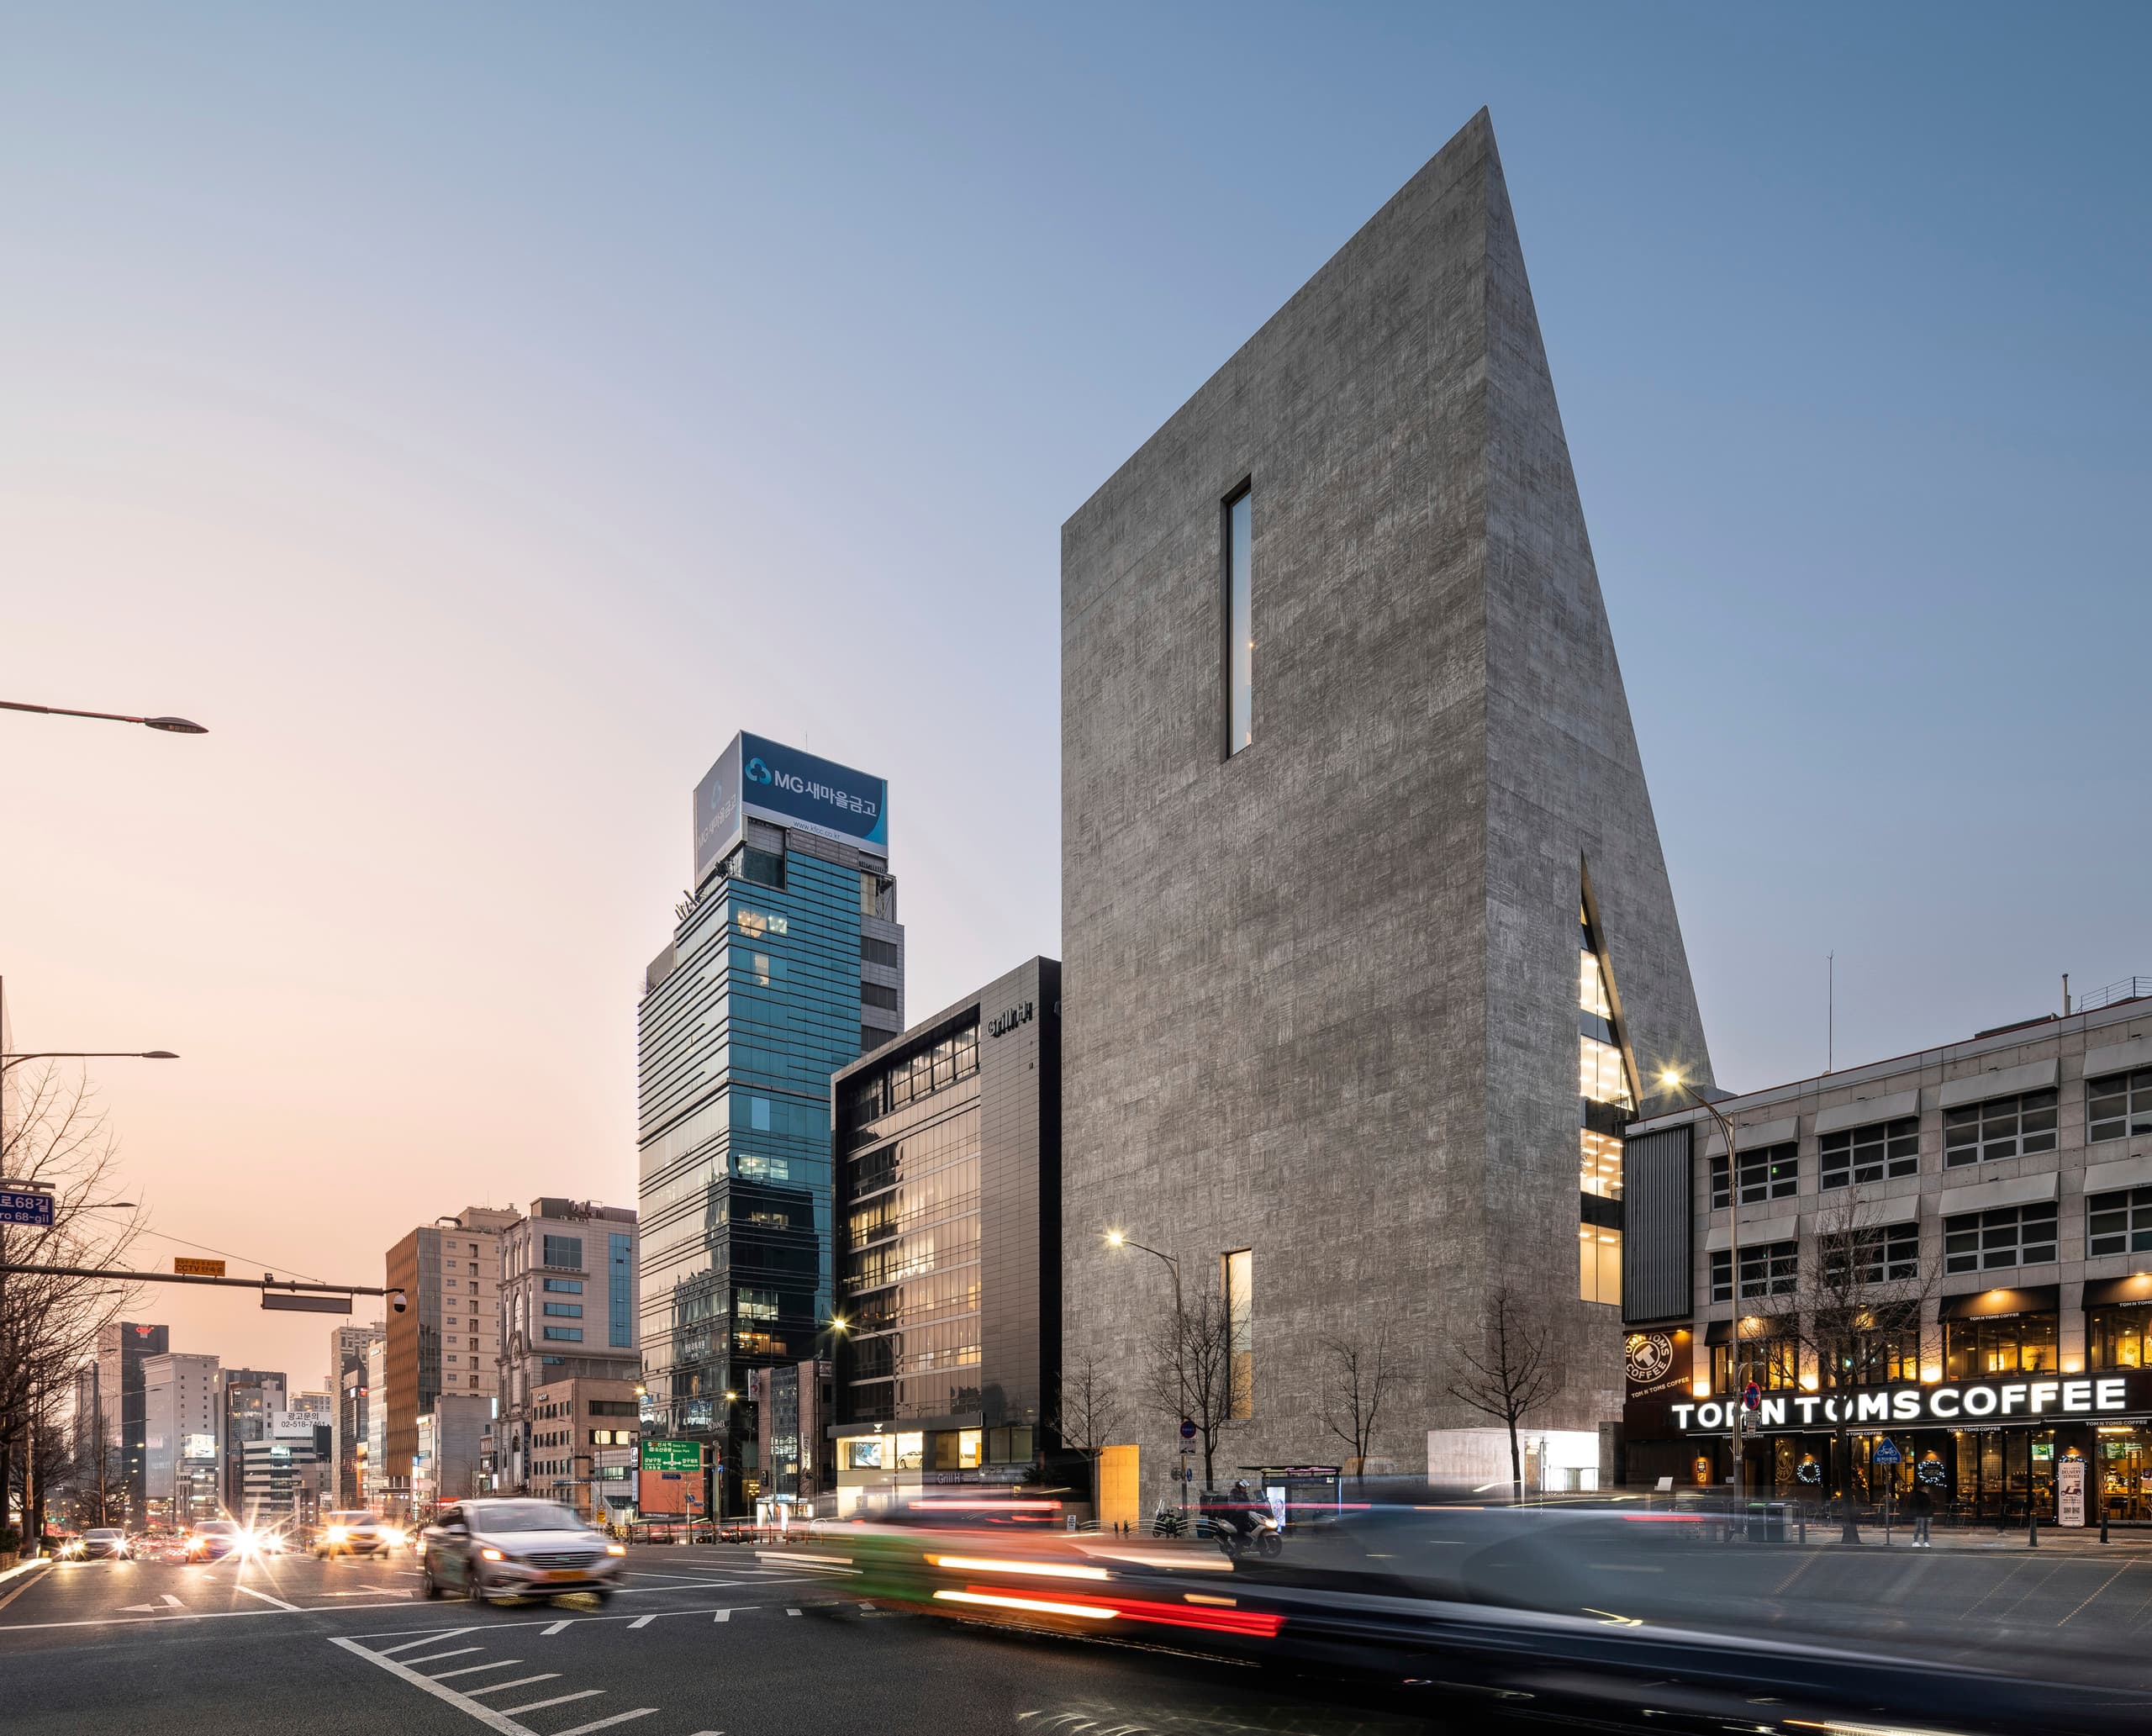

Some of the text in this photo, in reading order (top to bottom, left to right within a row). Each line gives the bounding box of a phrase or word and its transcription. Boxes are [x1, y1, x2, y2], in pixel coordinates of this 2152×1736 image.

[774, 770, 877, 817] MG 새마을금고
[793, 821, 841, 840] www.kfcc.co.kr
[0, 1195, 49, 1213] 로68길
[15, 1212, 49, 1224] 68-gil
[1626, 1360, 1667, 1380] COFFEE
[1648, 1384, 1666, 1393] TOMS
[1666, 1377, 1690, 1388] COFFEE
[1761, 1398, 1785, 1425] N
[1794, 1390, 1921, 1424] TOMS
[1929, 1378, 2126, 1417] COFFEE
[937, 1473, 953, 1485] Grill
[954, 1472, 961, 1484] H
